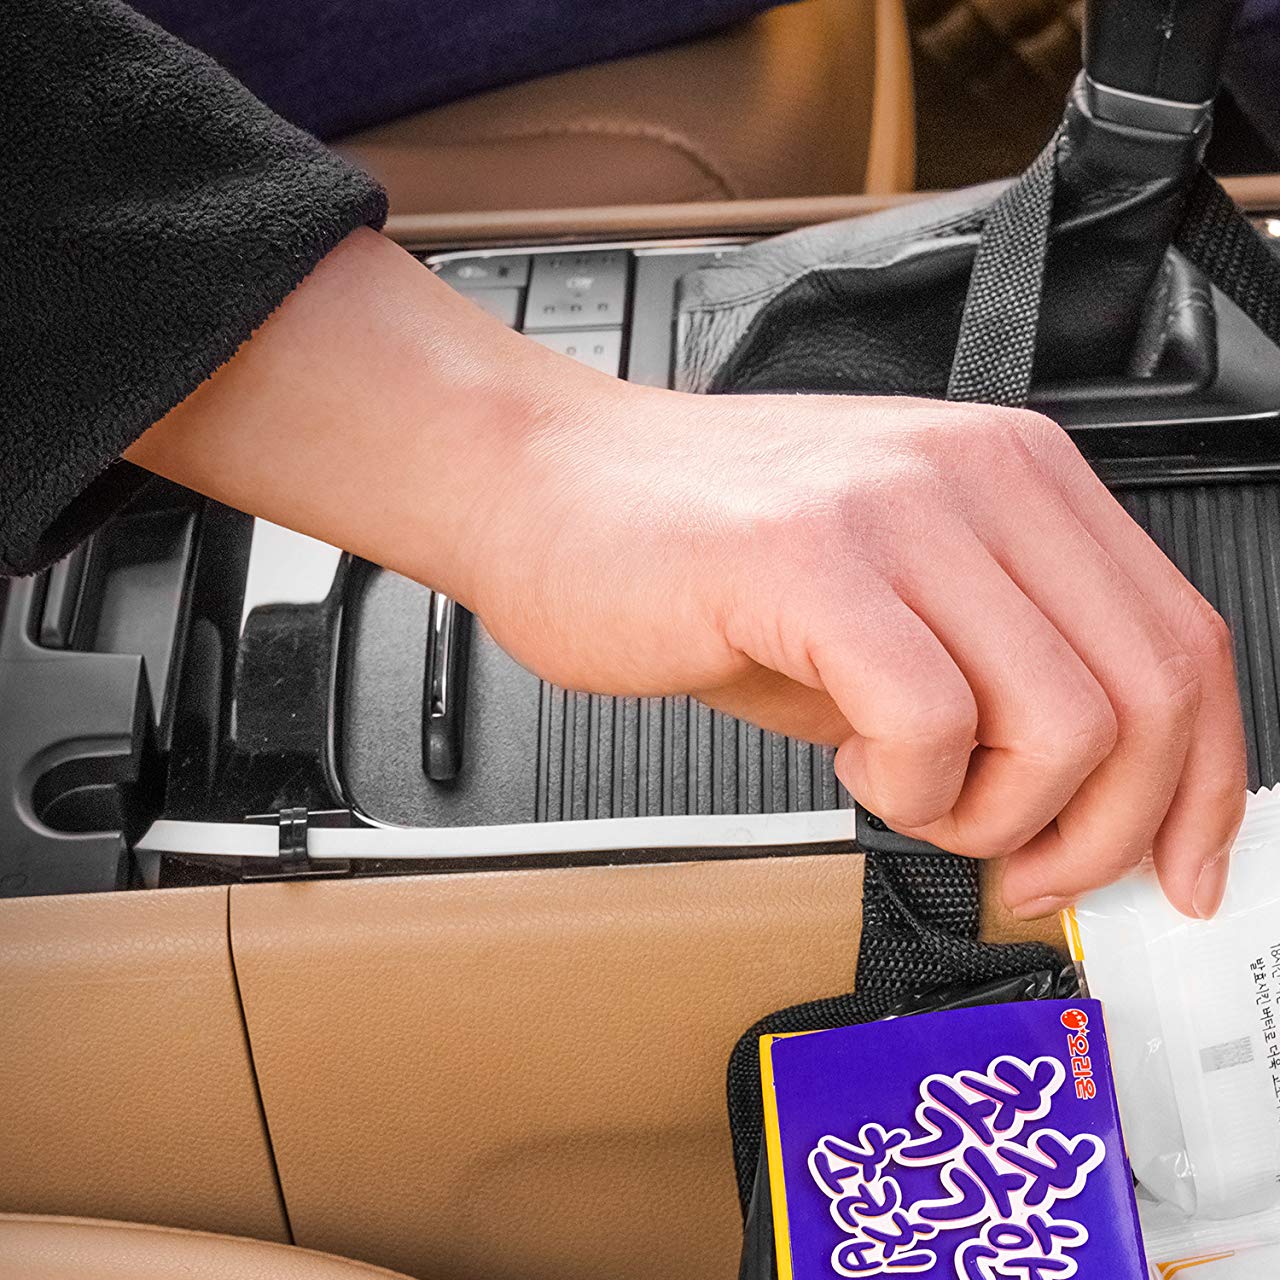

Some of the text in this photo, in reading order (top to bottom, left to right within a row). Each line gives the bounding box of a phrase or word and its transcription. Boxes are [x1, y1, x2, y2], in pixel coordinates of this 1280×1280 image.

[1250, 957, 1271, 1005] 발효시킨
[1260, 1006, 1276, 1043] 버터로
[1067, 1034, 1096, 1100] 오리온
